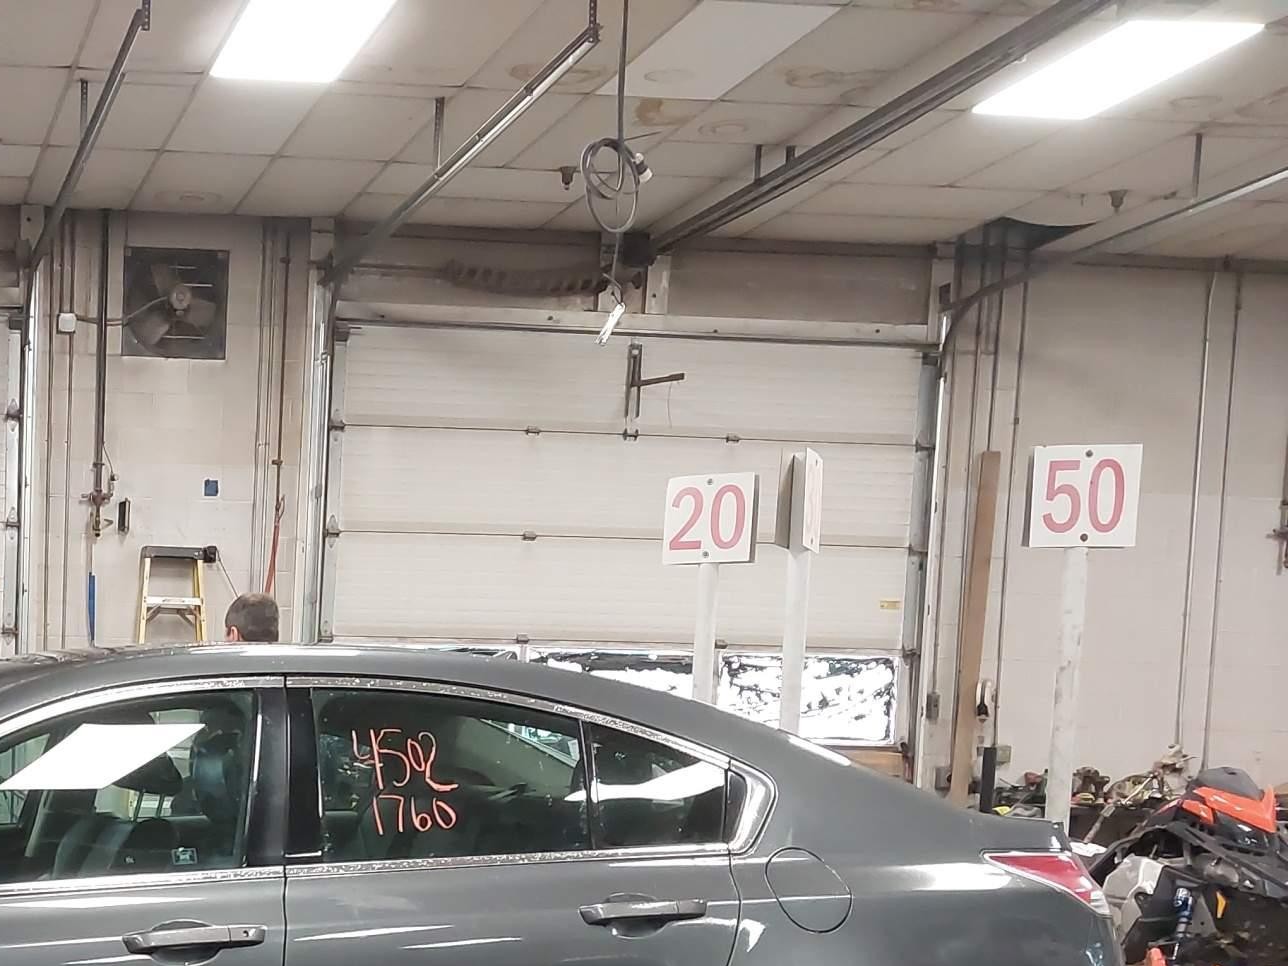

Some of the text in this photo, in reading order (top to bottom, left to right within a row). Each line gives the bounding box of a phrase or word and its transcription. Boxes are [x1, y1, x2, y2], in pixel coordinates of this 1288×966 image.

[668, 483, 746, 551] 20
[1042, 458, 1126, 534] 50
[351, 728, 460, 792] 4502
[372, 793, 457, 835] 1760
